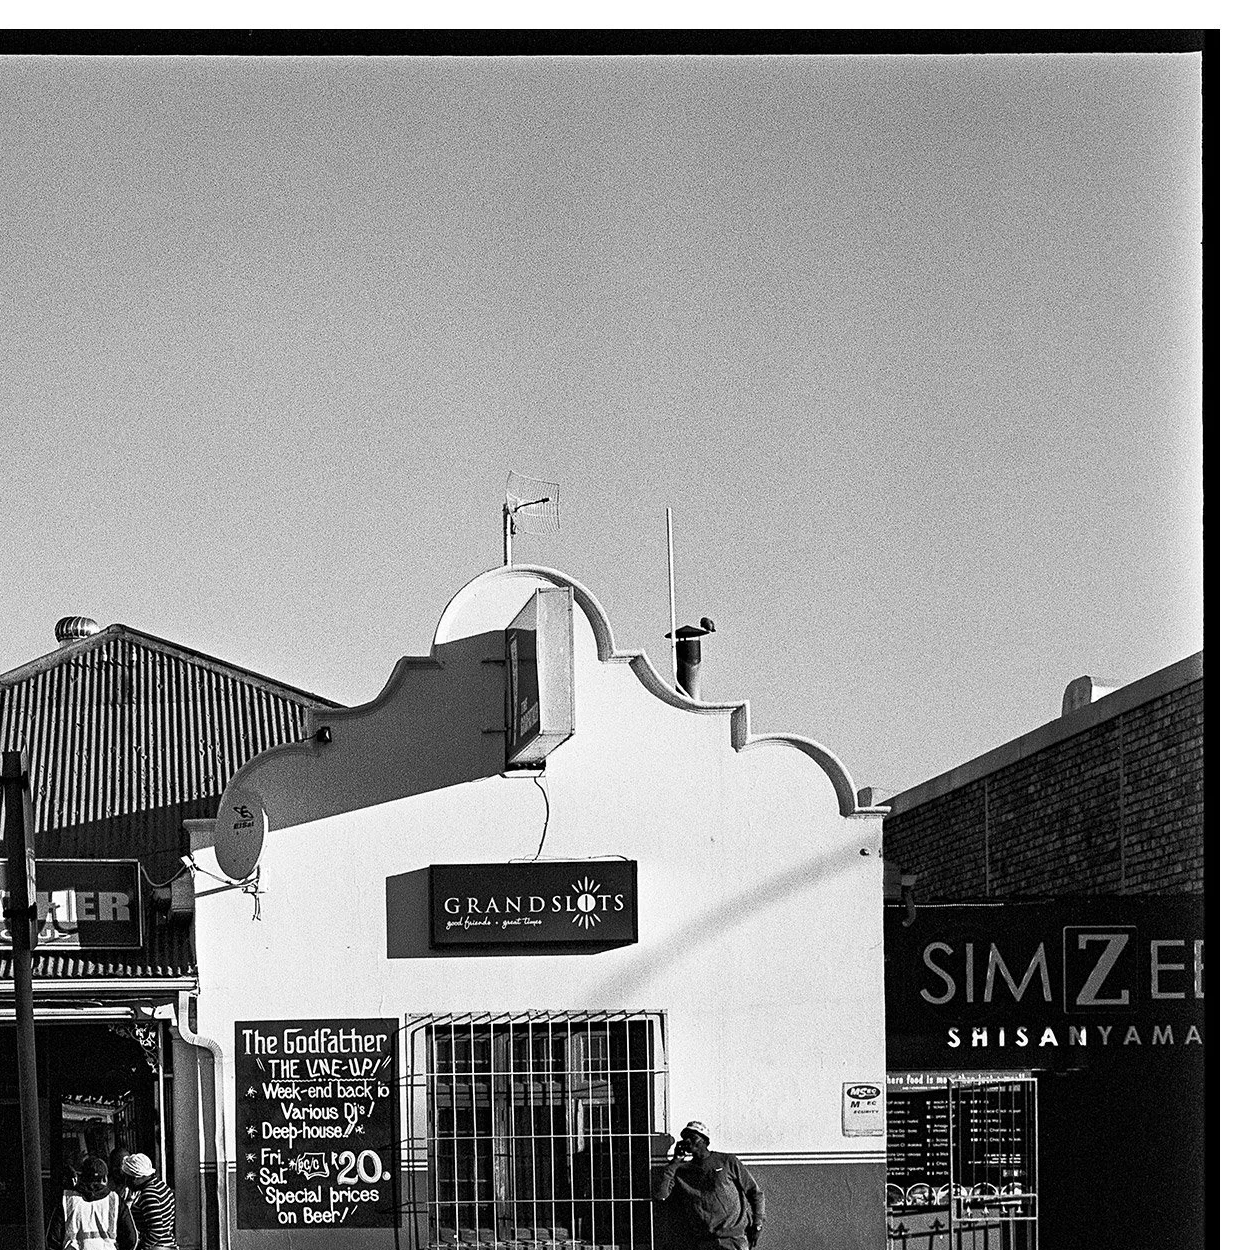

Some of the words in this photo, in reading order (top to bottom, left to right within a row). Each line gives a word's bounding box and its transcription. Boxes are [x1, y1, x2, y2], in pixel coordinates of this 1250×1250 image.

[446, 916, 463, 930] good
[464, 916, 491, 930] friends
[502, 917, 521, 930] great
[242, 1029, 278, 1055] The
[283, 1028, 388, 1054] Godfather
[947, 1025, 1203, 1048] SHISANYAMA
[906, 1073, 924, 1085] food
[262, 1081, 332, 1102] Week-end
[338, 1080, 373, 1101] back
[281, 1102, 339, 1120] Various
[261, 1148, 285, 1166] Fri.
[260, 1167, 288, 1185] Sat.
[330, 1186, 380, 1212] prices
[277, 1210, 297, 1224] on
